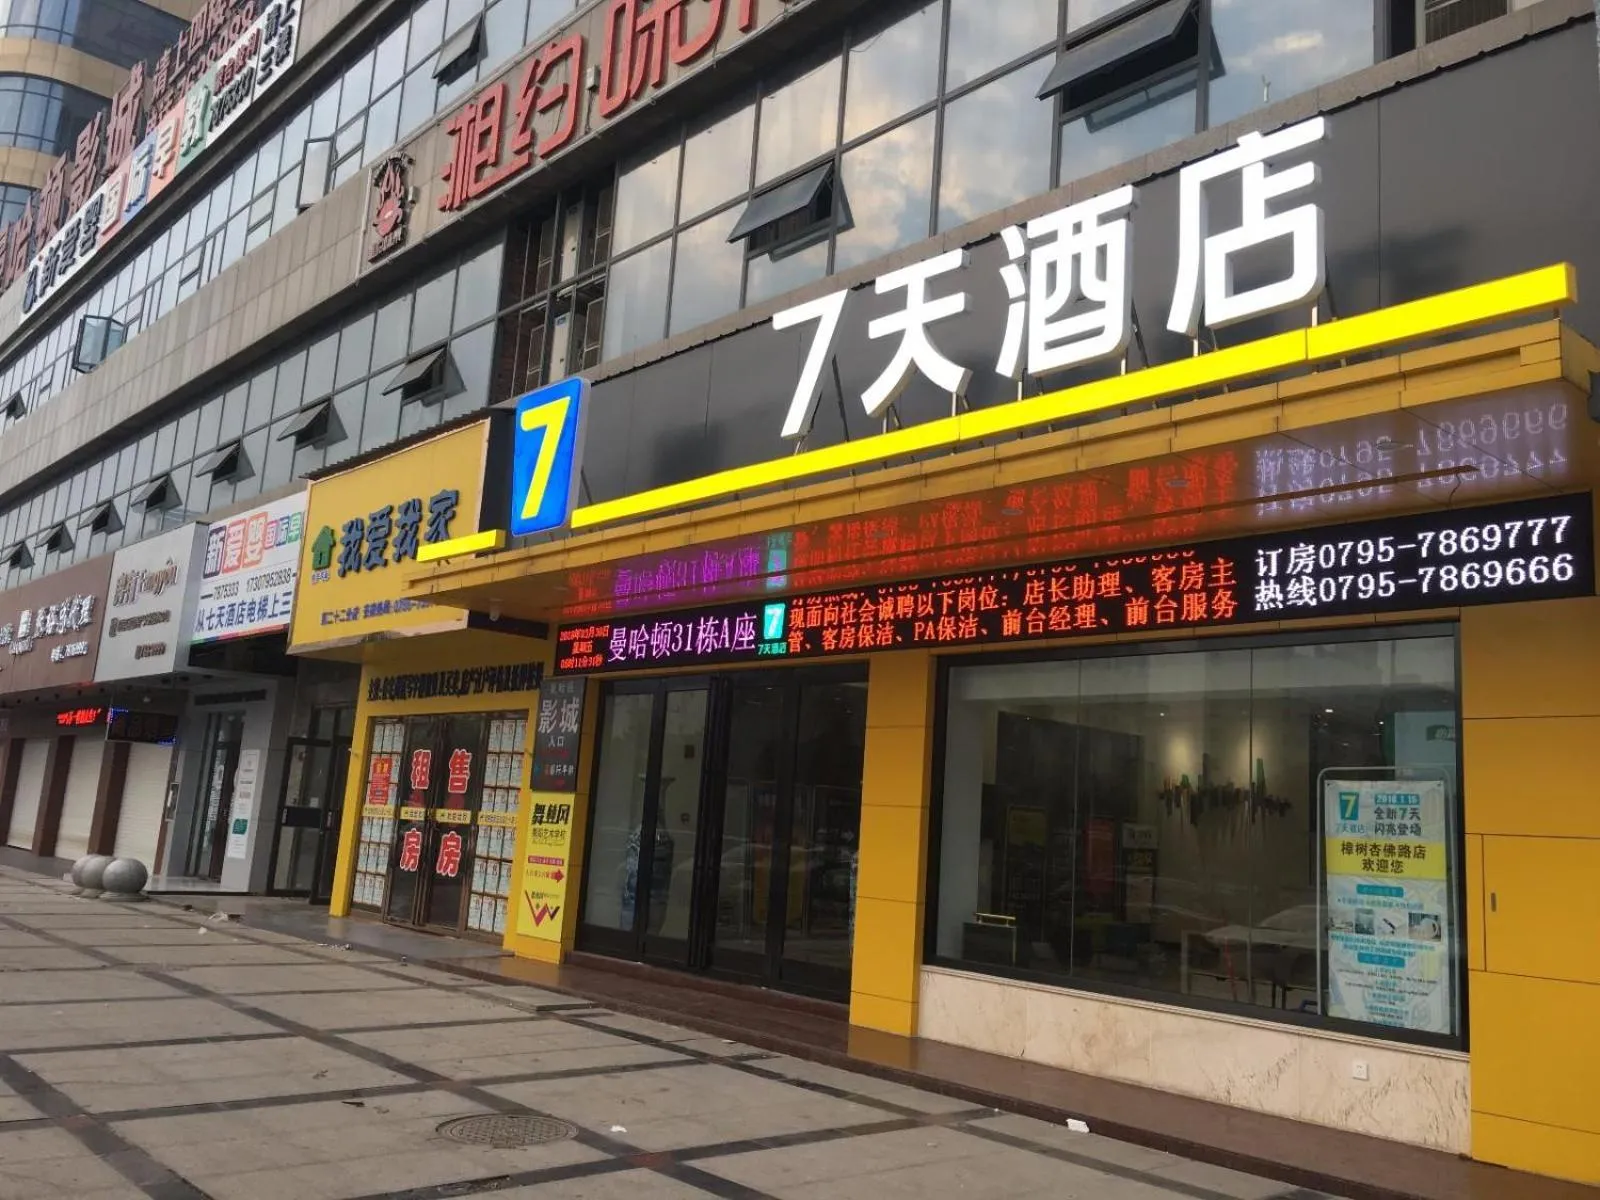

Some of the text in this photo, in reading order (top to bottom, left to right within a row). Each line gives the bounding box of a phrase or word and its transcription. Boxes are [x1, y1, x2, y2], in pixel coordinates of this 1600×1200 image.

[773, 117, 1328, 438] 7天酒店
[520, 396, 572, 520] 7
[338, 489, 460, 577] 我爱我家
[1255, 514, 1573, 577] 订房0795-7869777
[1254, 553, 1575, 611] 热线0795-7869666
[195, 591, 293, 635] 从七天酒店电梯上三
[608, 612, 757, 663] 曼哈顿31栋A座
[538, 696, 580, 734] 影城
[1341, 795, 1357, 819] 7
[1341, 840, 1428, 860] 樟树杏佛路店
[1361, 858, 1405, 874] 欢迎您
